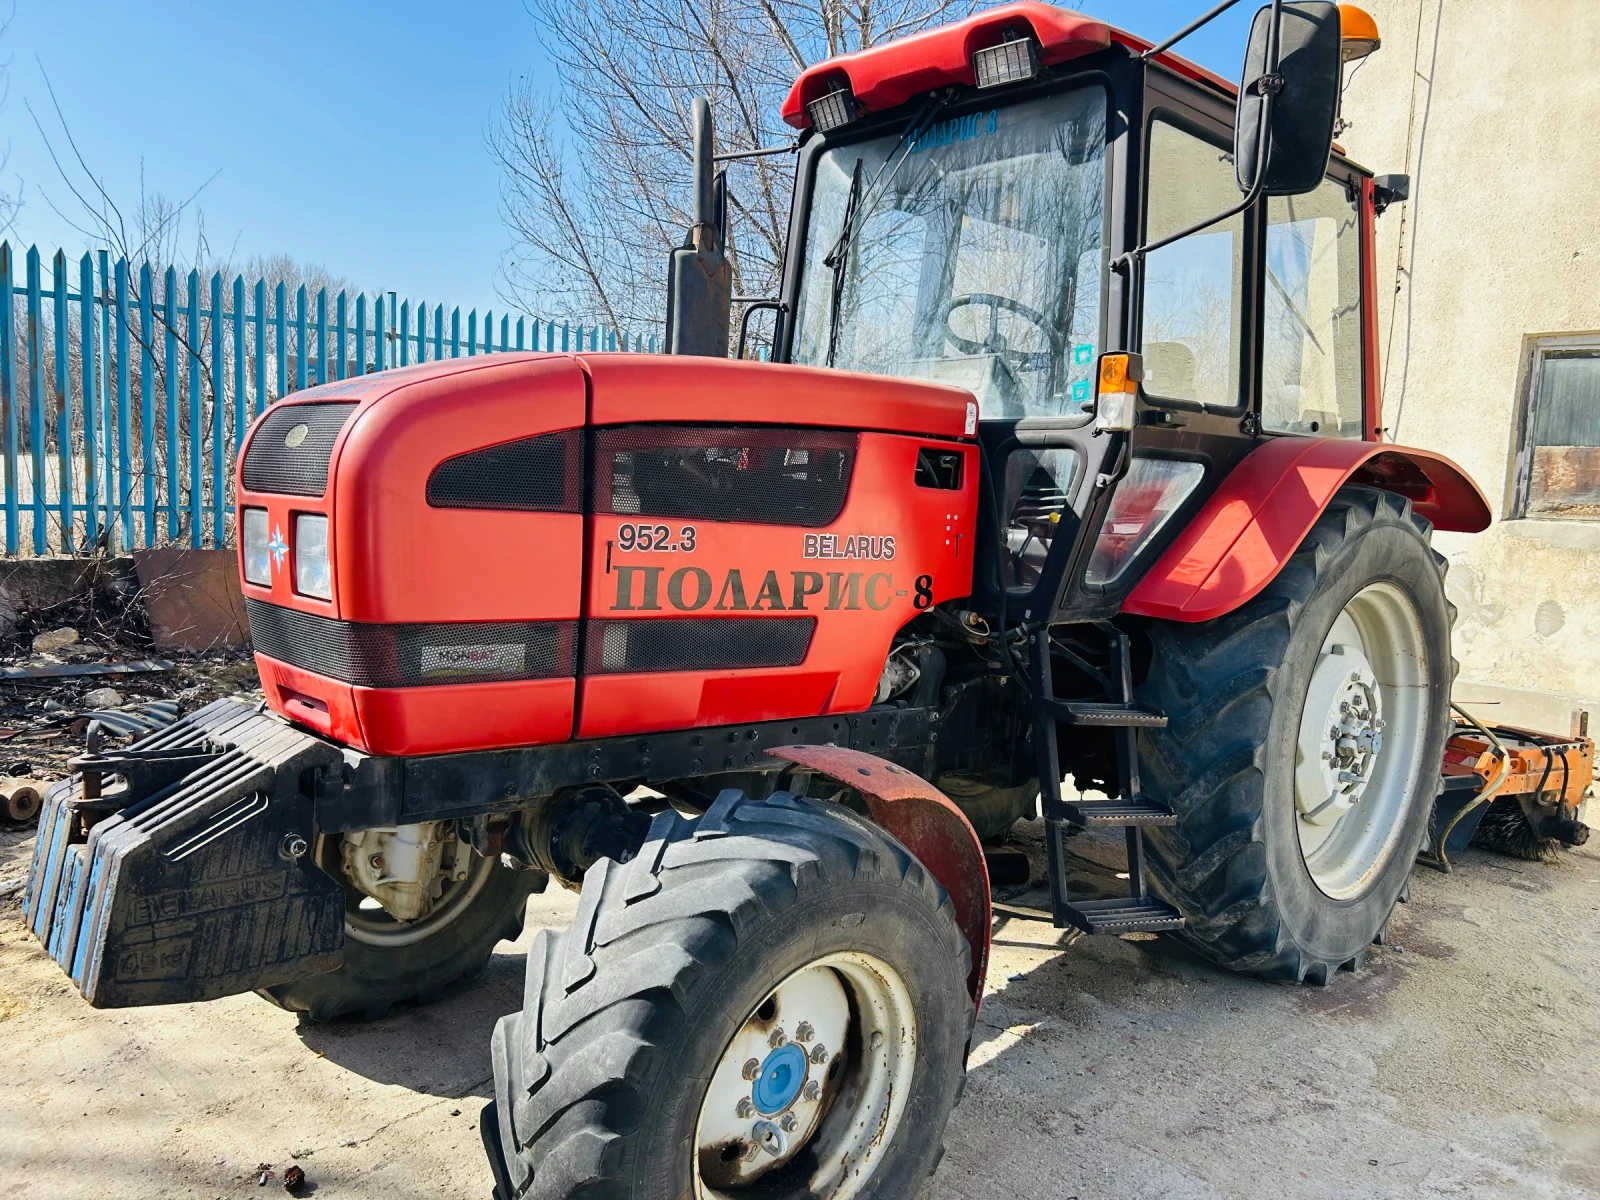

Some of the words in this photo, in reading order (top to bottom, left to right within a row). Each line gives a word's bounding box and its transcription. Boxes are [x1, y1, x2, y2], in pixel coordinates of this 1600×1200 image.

[618, 523, 697, 552] 952.3
[803, 533, 896, 560] BELARUS
[609, 565, 934, 611] ПОЛАРИС-8
[134, 876, 283, 923] BELARUS
